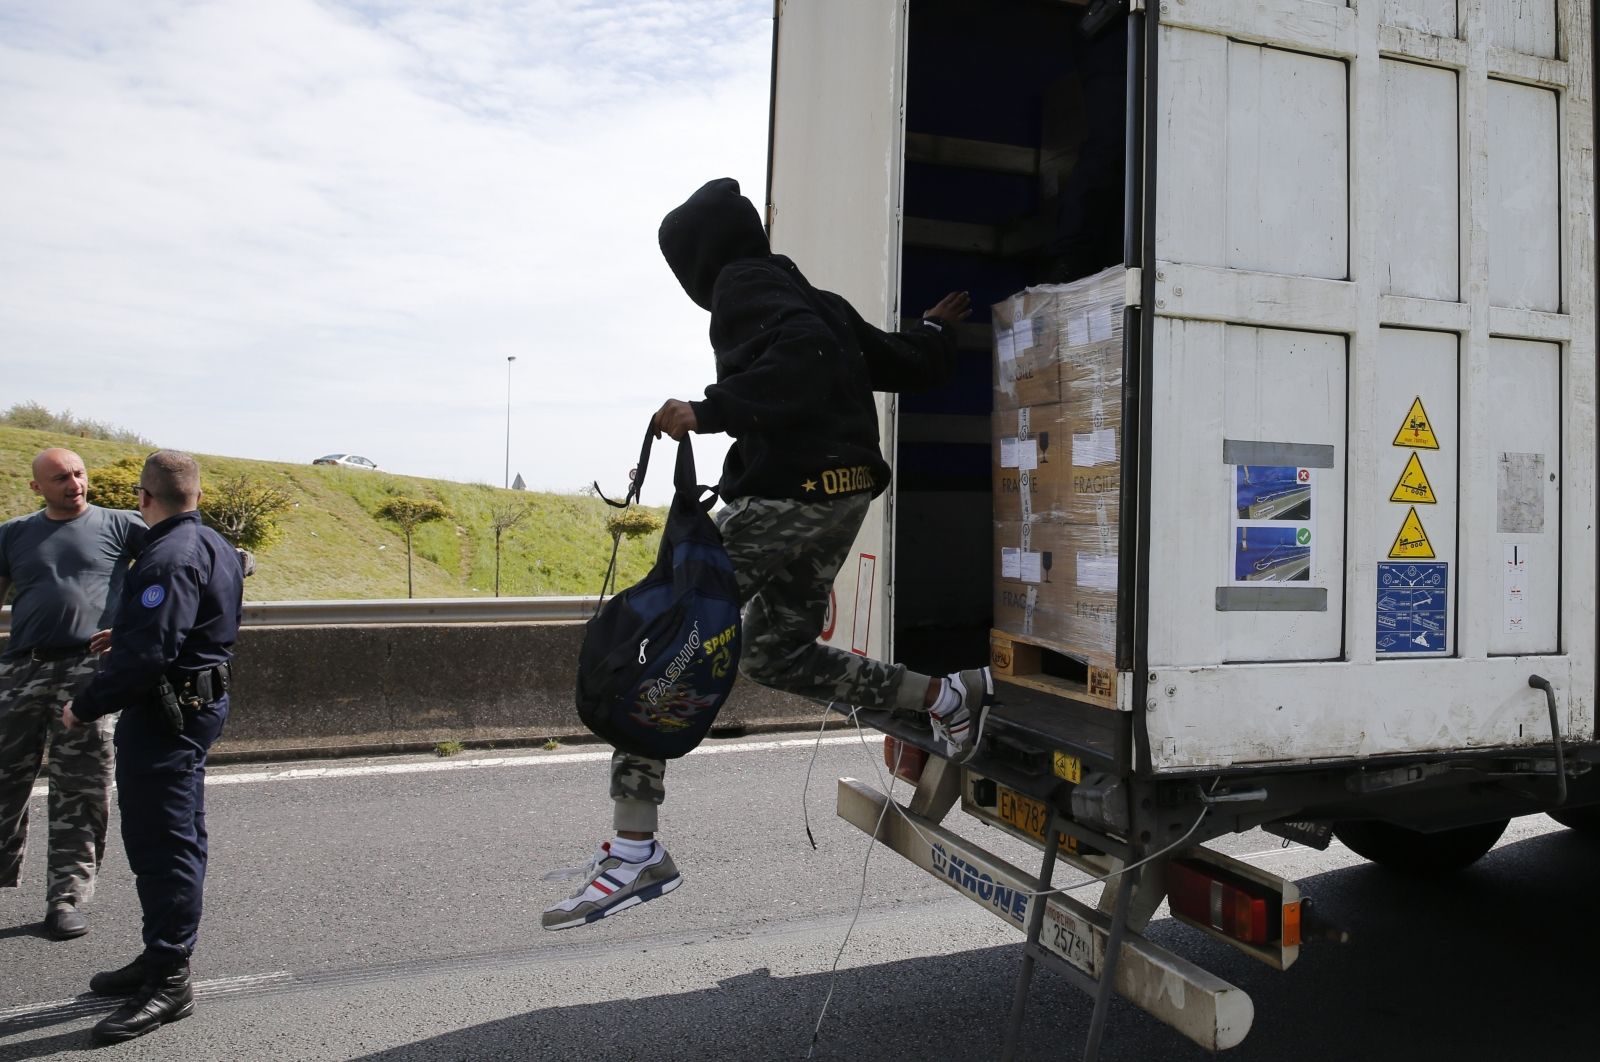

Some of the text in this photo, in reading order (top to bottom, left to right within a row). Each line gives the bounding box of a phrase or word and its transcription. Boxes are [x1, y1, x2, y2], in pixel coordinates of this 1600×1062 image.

[1002, 477, 1038, 494] FRALE
[1003, 591, 1039, 611] FRAGE
[703, 623, 737, 656] SPORT
[947, 855, 1029, 923] KRONE
